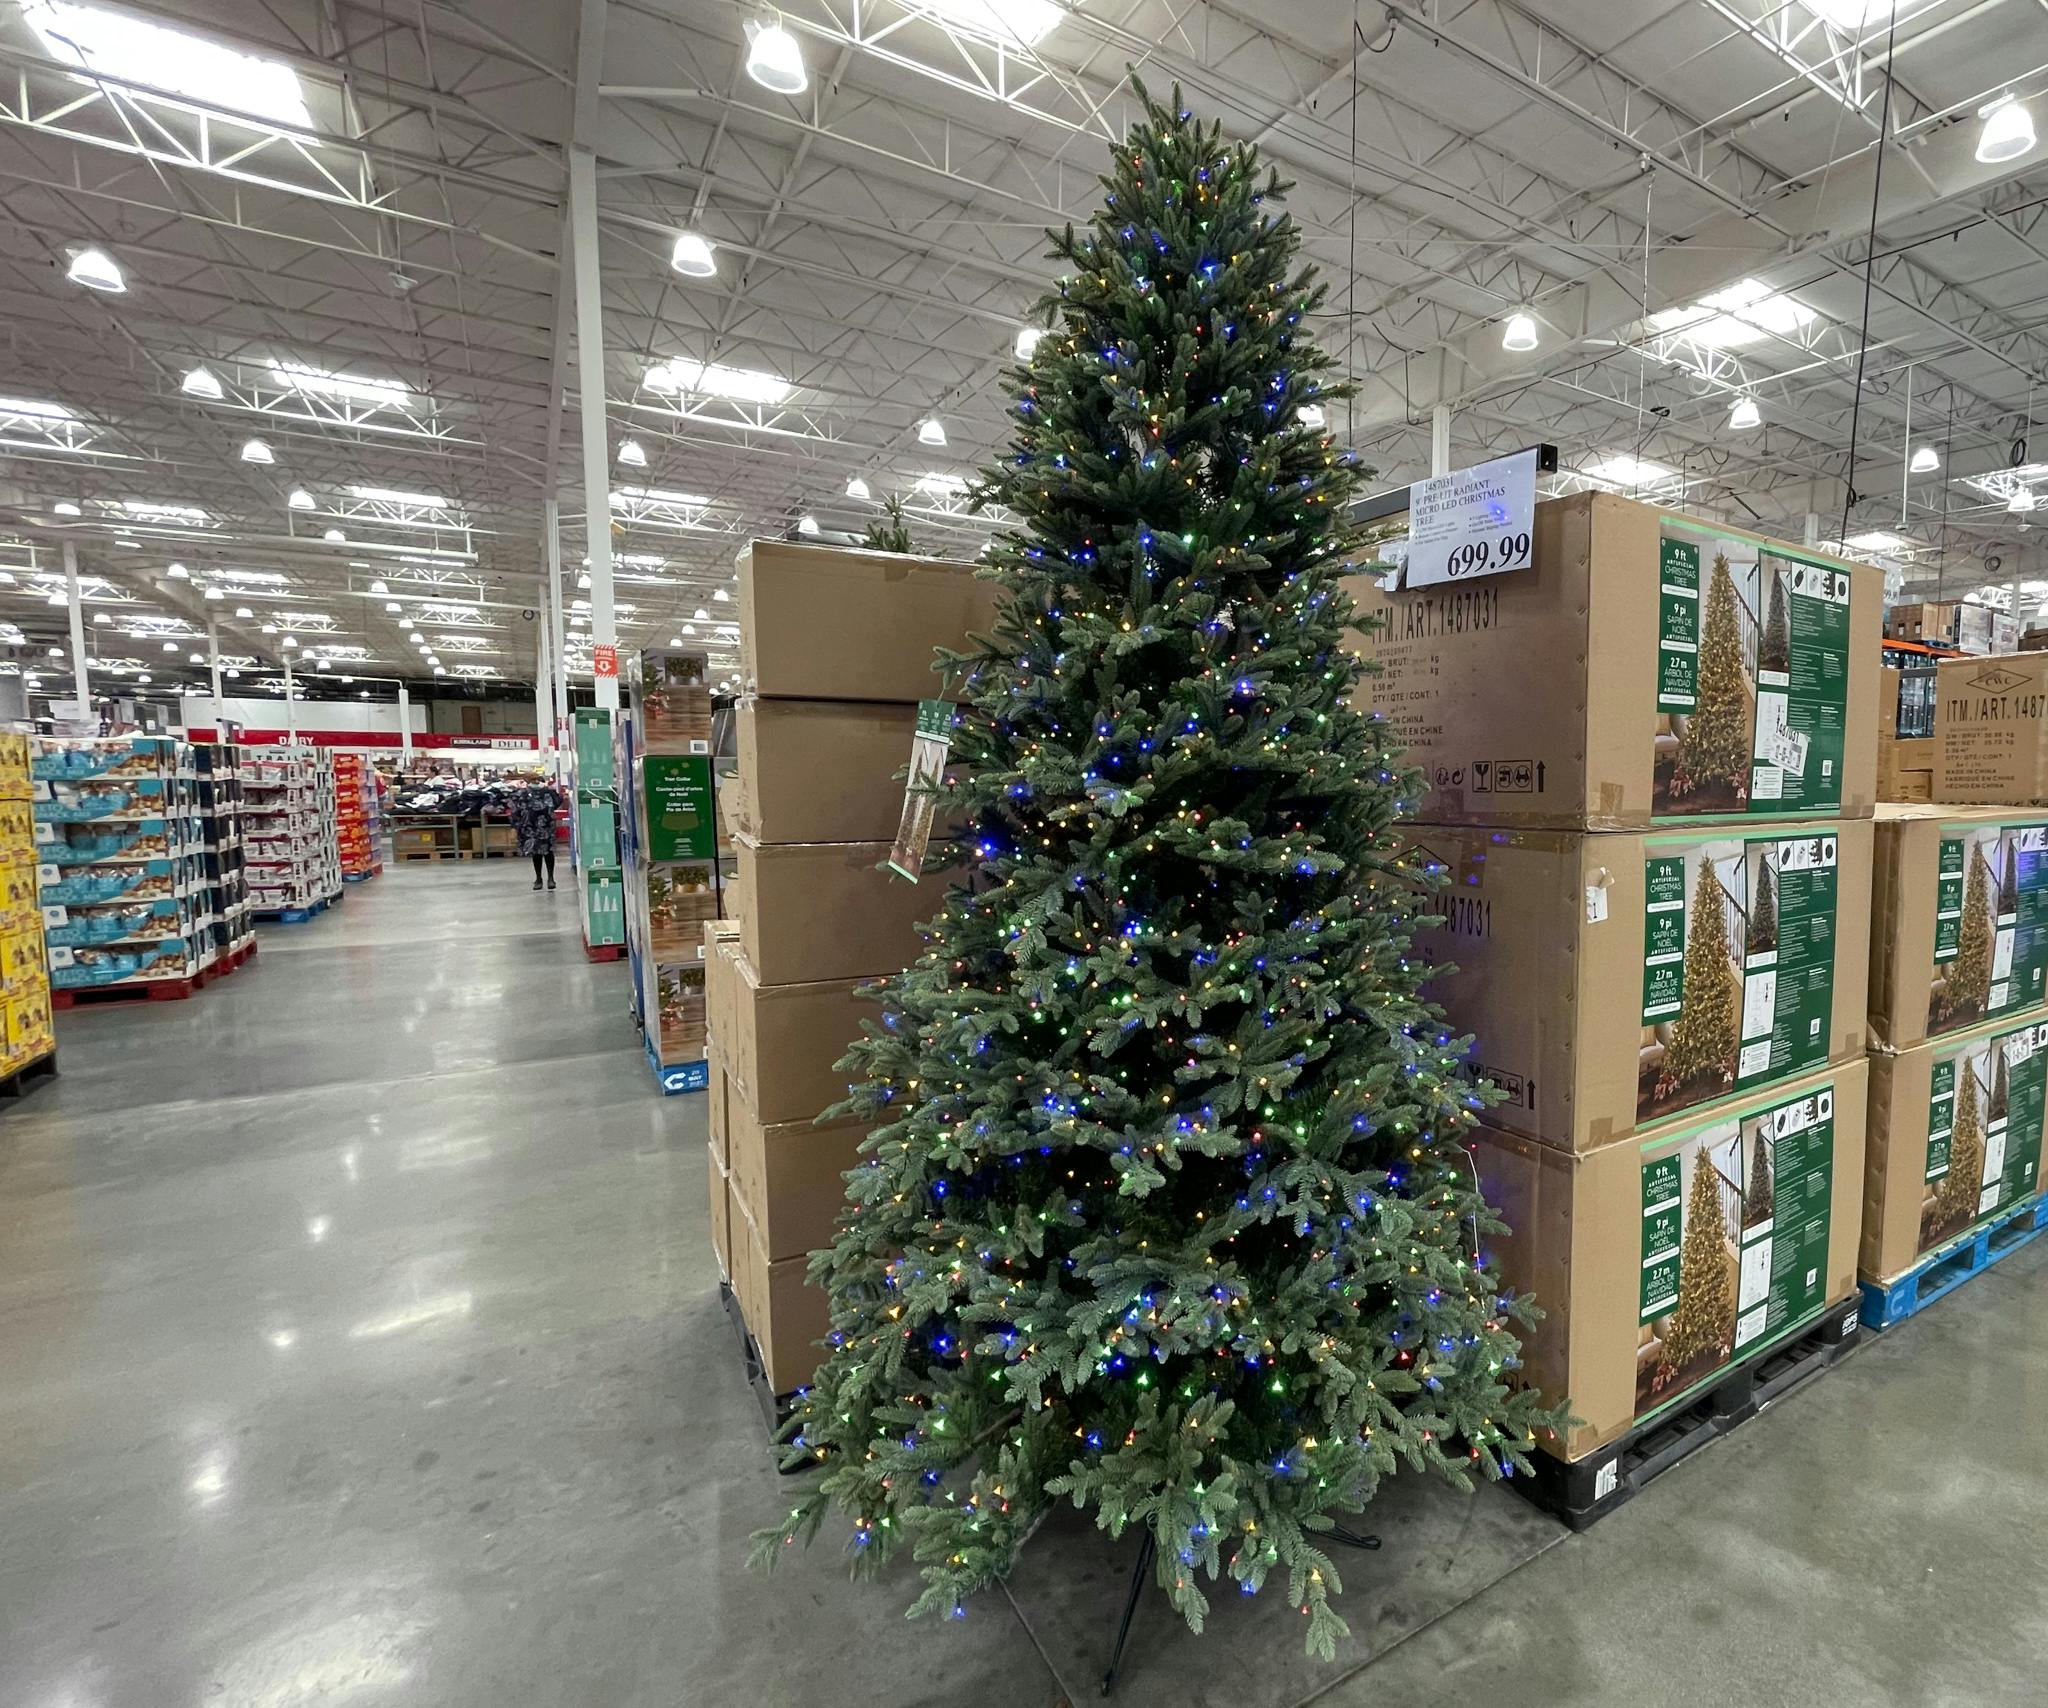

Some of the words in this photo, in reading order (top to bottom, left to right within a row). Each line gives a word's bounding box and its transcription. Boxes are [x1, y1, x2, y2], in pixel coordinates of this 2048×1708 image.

[1425, 477, 1454, 494] 1487031
[1454, 479, 1491, 496] RADIANT
[1416, 503, 1440, 517] MICRO
[1442, 499, 1457, 511] LED
[1459, 486, 1506, 506] CHRISTMAS
[1416, 515, 1433, 527] TREE
[1448, 533, 1530, 576] 699.99
[1674, 548, 1680, 559] 9
[1680, 550, 1687, 561] ft
[1665, 565, 1696, 579] CHRISTMAS
[1674, 576, 1688, 587] TREE
[1674, 603, 1679, 614] 9
[1680, 605, 1687, 617] pi
[1667, 615, 1684, 625] SAPIN
[1685, 618, 1693, 627] DE
[1680, 660, 1687, 669] m
[1684, 670, 1693, 679] DE
[1665, 678, 1691, 688] NAVIDAD
[1402, 715, 1424, 724] CHINA
[1409, 727, 1419, 735] EN
[1420, 725, 1443, 735] CHINE
[1409, 738, 1432, 747] CHINA
[1659, 866, 1665, 876] 9
[1665, 865, 1672, 876] ft
[1650, 882, 1682, 893] CHRISTMAS
[1659, 892, 1673, 900] TREE
[1660, 918, 1665, 929] 9
[1665, 917, 1672, 930] pi
[1652, 930, 1670, 940] SAPIN
[1670, 929, 1678, 937] DE
[1670, 978, 1678, 987] DE
[1650, 987, 1677, 999] NAVIDAD
[1655, 1168, 1661, 1178] 9
[1661, 1166, 1668, 1176] ft
[1646, 1179, 1678, 1197] CHRISTMAS
[1656, 1191, 1670, 1202] TREE
[1656, 1219, 1661, 1229] 9
[1662, 1216, 1669, 1230] pi
[1649, 1229, 1667, 1242] SAPIN
[1667, 1225, 1675, 1235] DE
[1663, 1267, 1670, 1276] m
[1667, 1271, 1675, 1281] DE
[1647, 1282, 1674, 1298] NAVIDAD
